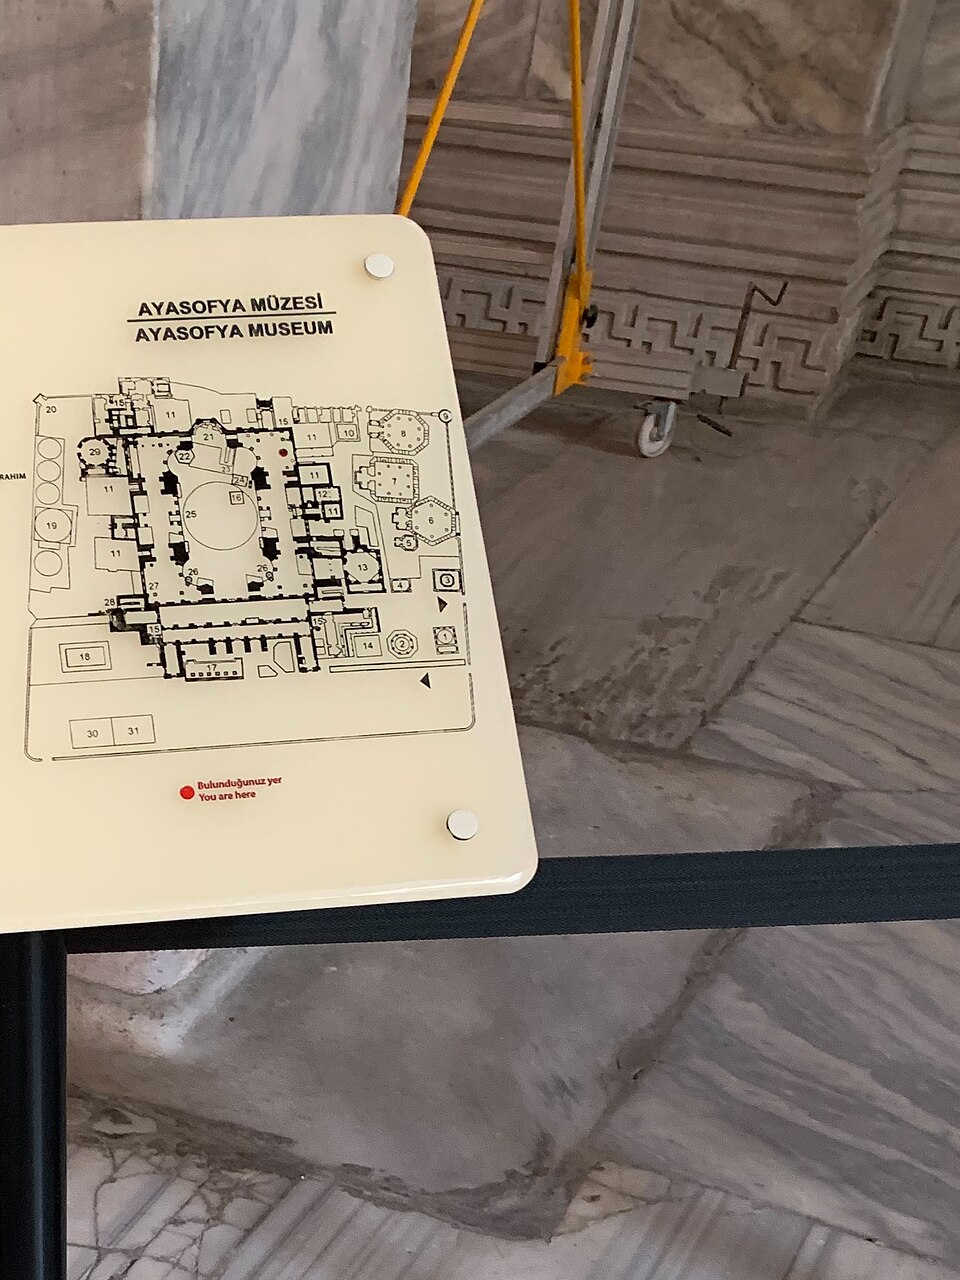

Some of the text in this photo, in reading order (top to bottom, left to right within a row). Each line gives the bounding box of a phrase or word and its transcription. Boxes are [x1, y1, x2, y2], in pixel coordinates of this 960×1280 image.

[138, 292, 323, 316] AYASOFYA MÜZESİ
[135, 320, 334, 342] AYASOFYA MUSEUM
[46, 406, 57, 414] 20
[203, 433, 214, 441] 21
[89, 448, 101, 456] 29
[185, 510, 197, 518] 25
[46, 522, 57, 530] 19
[357, 564, 368, 572] 13
[362, 642, 373, 650] 14
[79, 653, 91, 661] 18
[86, 730, 99, 738] 30
[127, 727, 139, 735] 31
[197, 777, 282, 790] Bulunduğunuz yer
[199, 793, 216, 802] You
[235, 790, 256, 799] here
